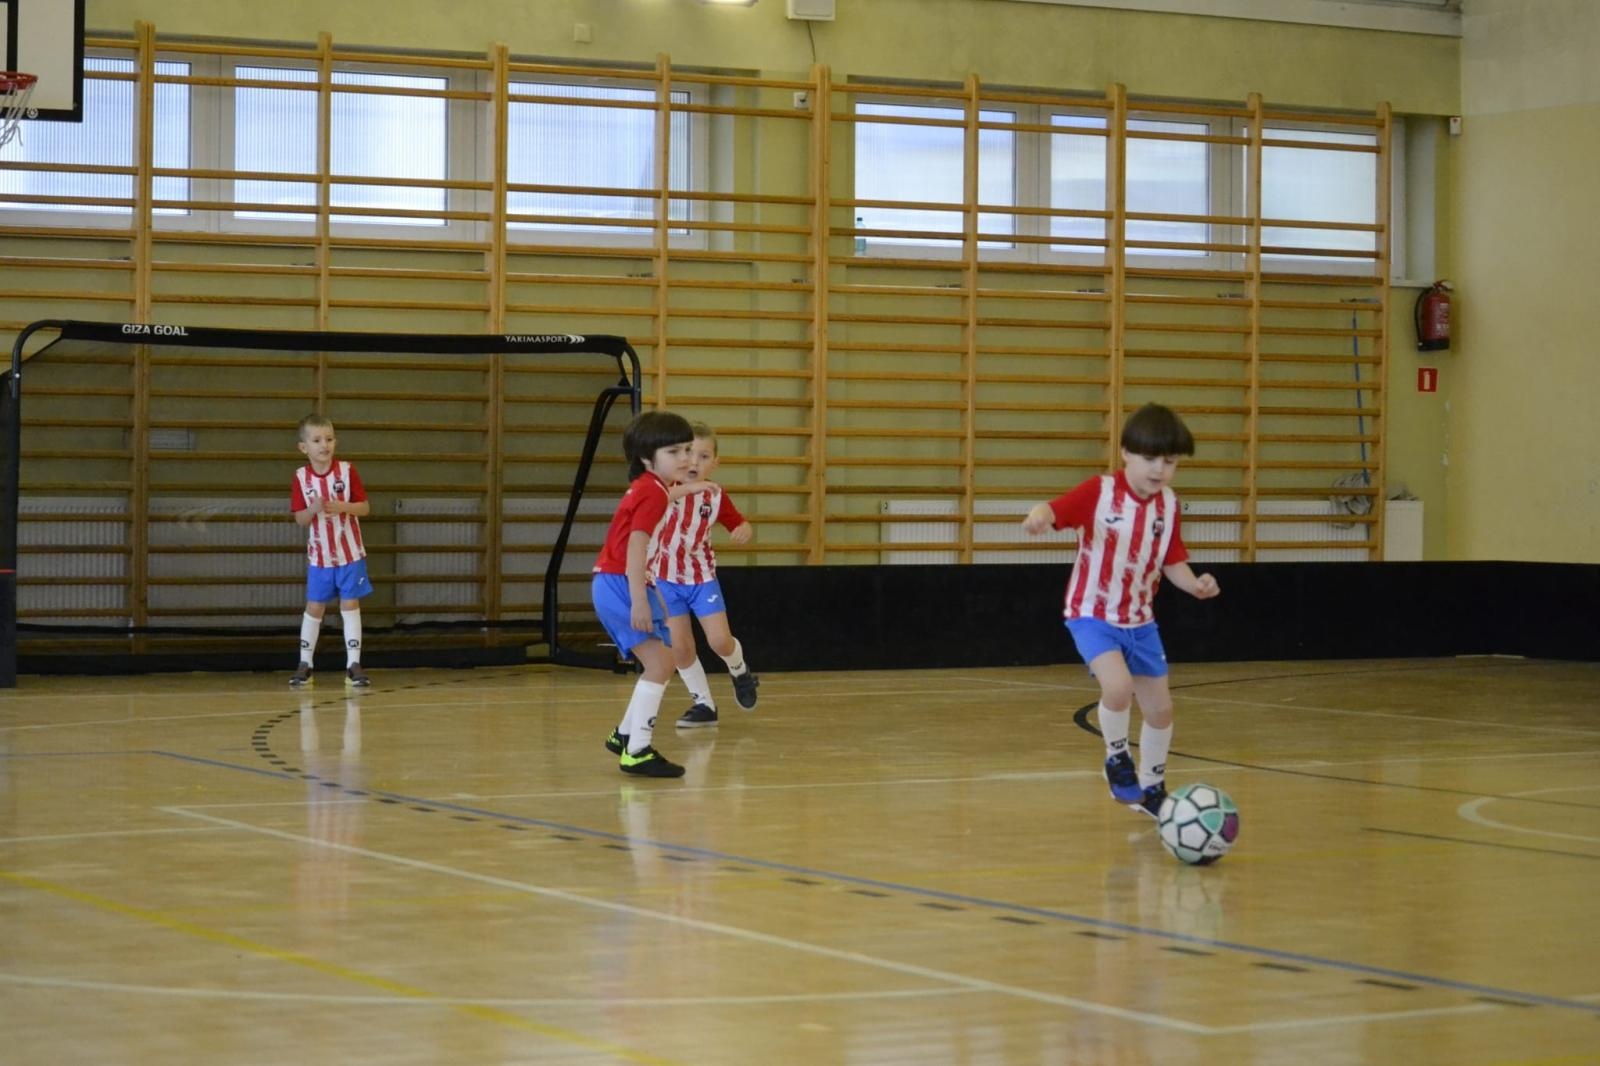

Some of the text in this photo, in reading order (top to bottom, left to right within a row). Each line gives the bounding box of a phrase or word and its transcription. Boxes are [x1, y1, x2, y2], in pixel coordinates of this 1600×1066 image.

[122, 324, 189, 336] GIZA GOAL
[505, 335, 567, 343] YAKIMASPORT
